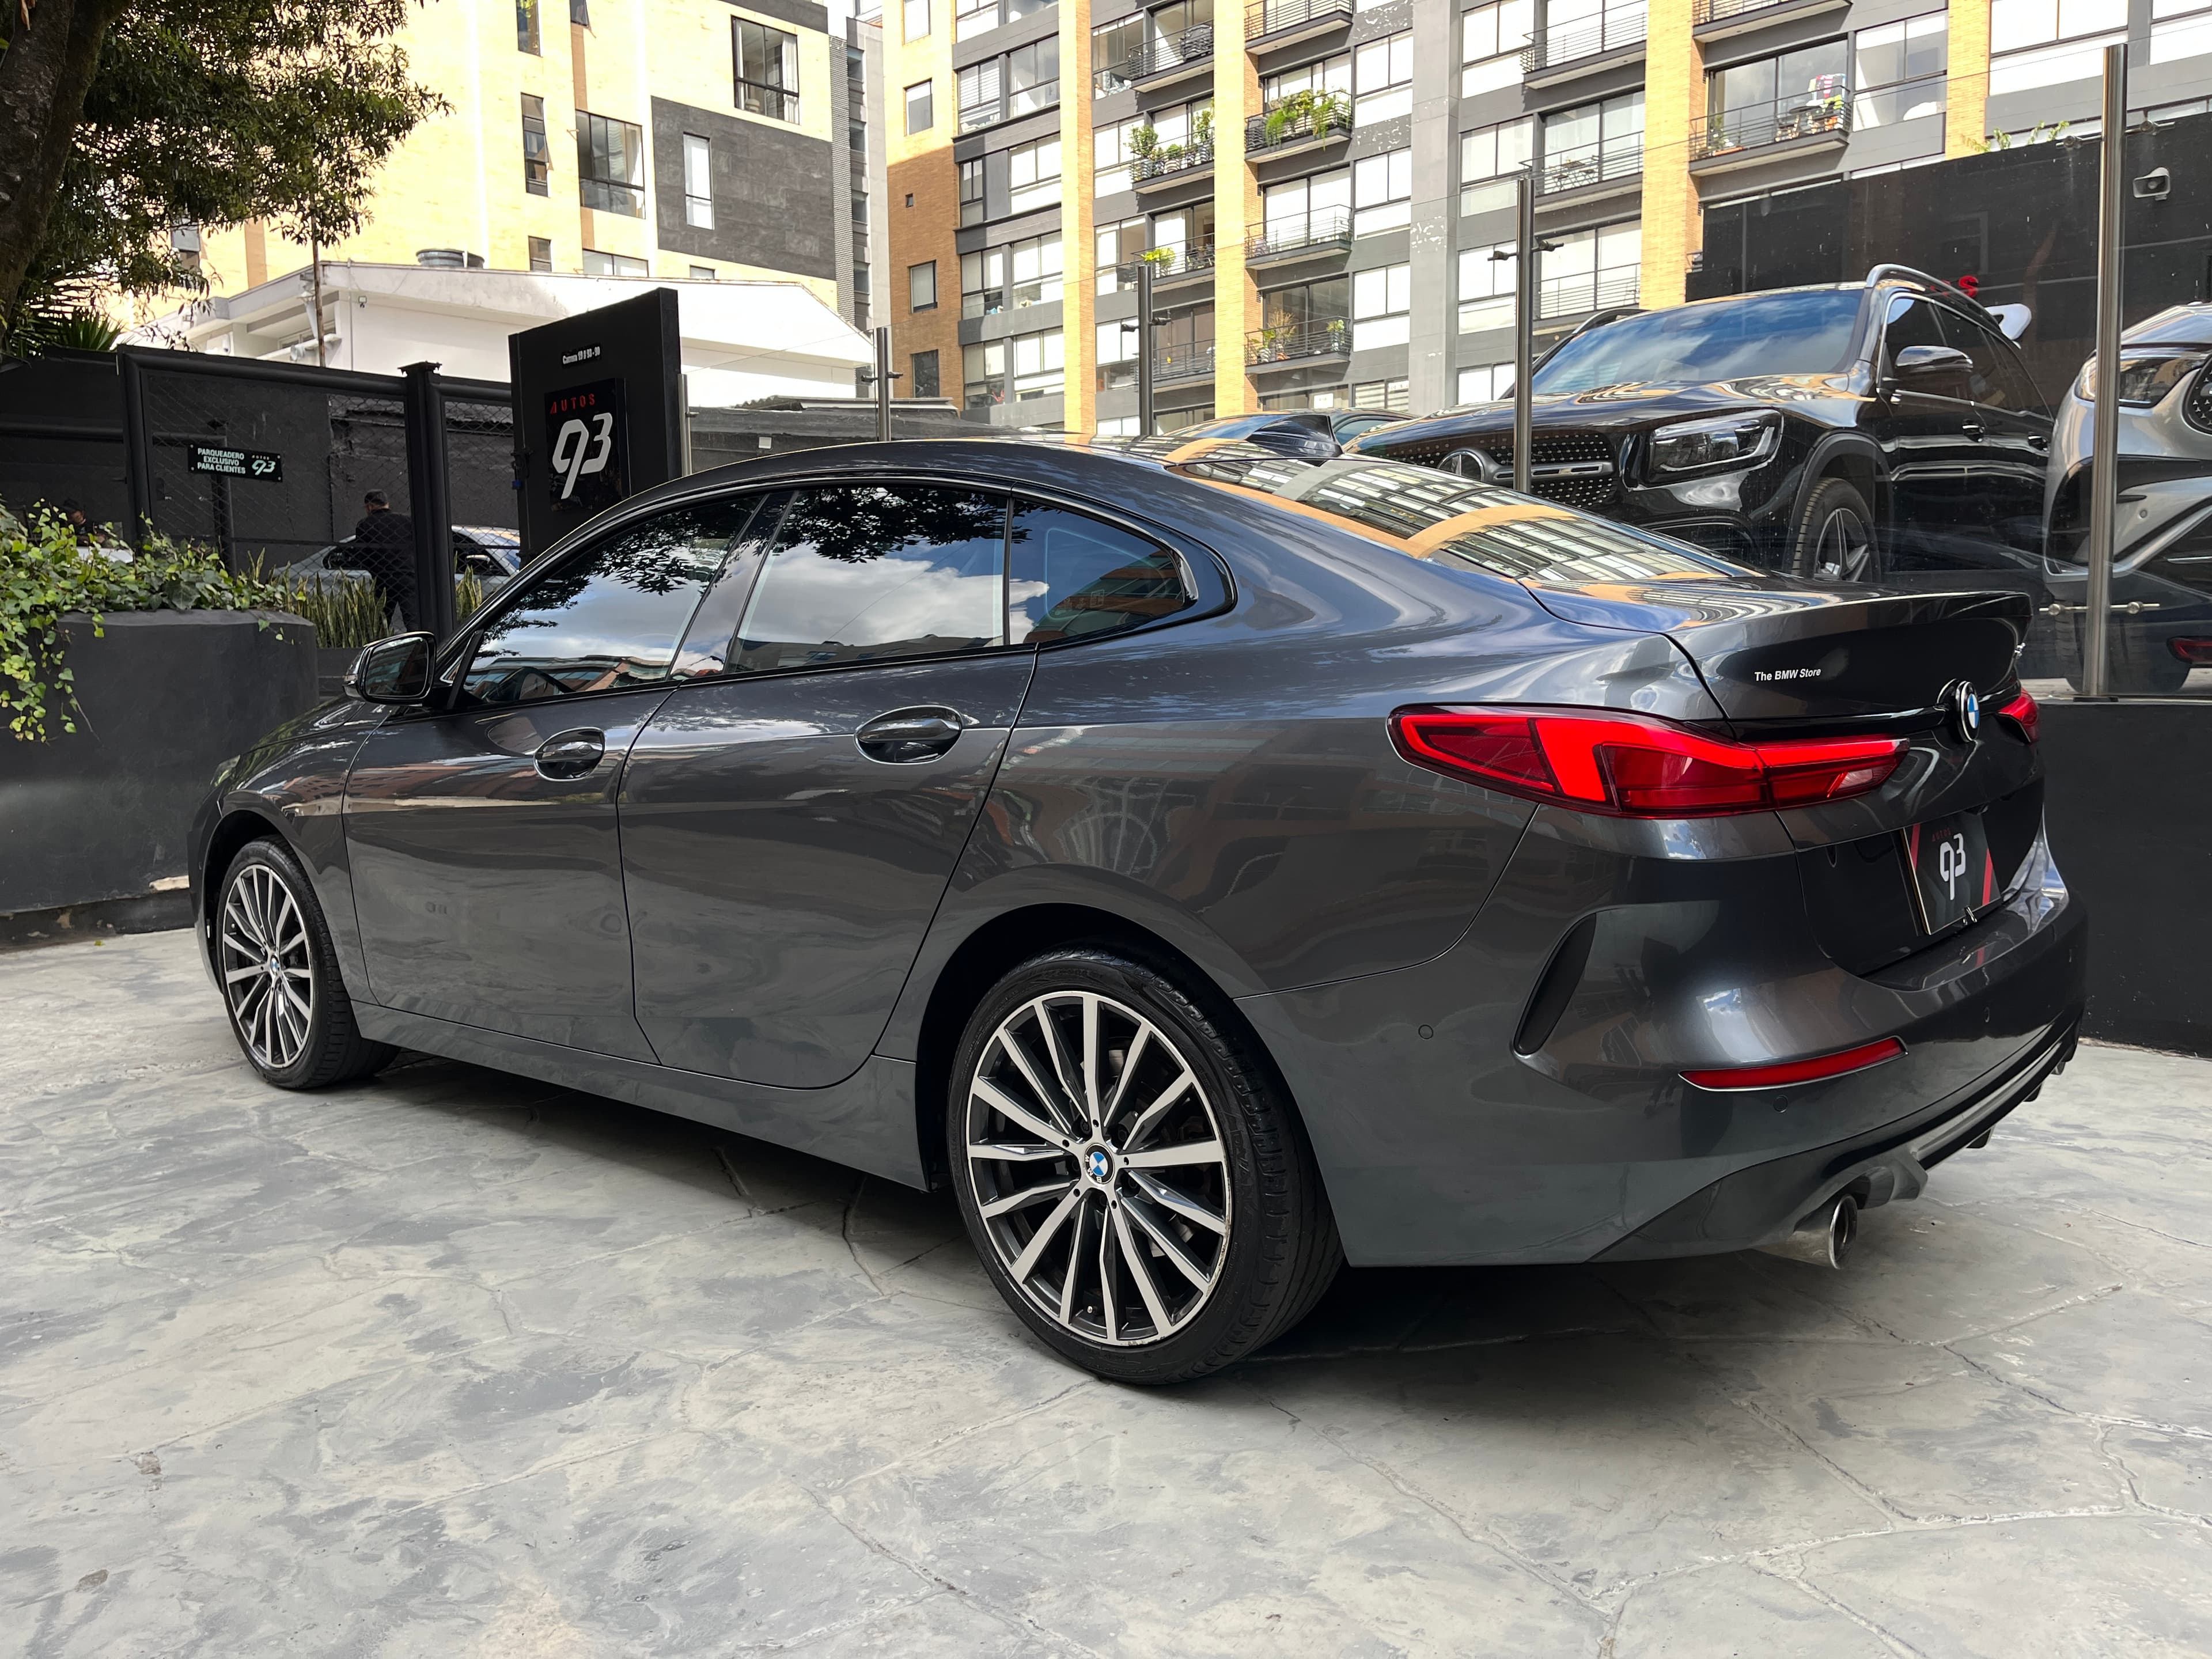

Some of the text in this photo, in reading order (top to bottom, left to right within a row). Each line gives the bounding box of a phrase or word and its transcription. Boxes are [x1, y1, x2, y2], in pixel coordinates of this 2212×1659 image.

[550, 393, 596, 414] AUTOS
[198, 448, 245, 460] PARQUEADERO
[203, 456, 239, 466] EXCLUSIVO
[552, 412, 613, 499] 93
[197, 462, 245, 474] PARA CLIENTES
[251, 459, 276, 475] 93
[1754, 668, 1821, 681] The BMW Store
[1940, 833, 1966, 901] 93
